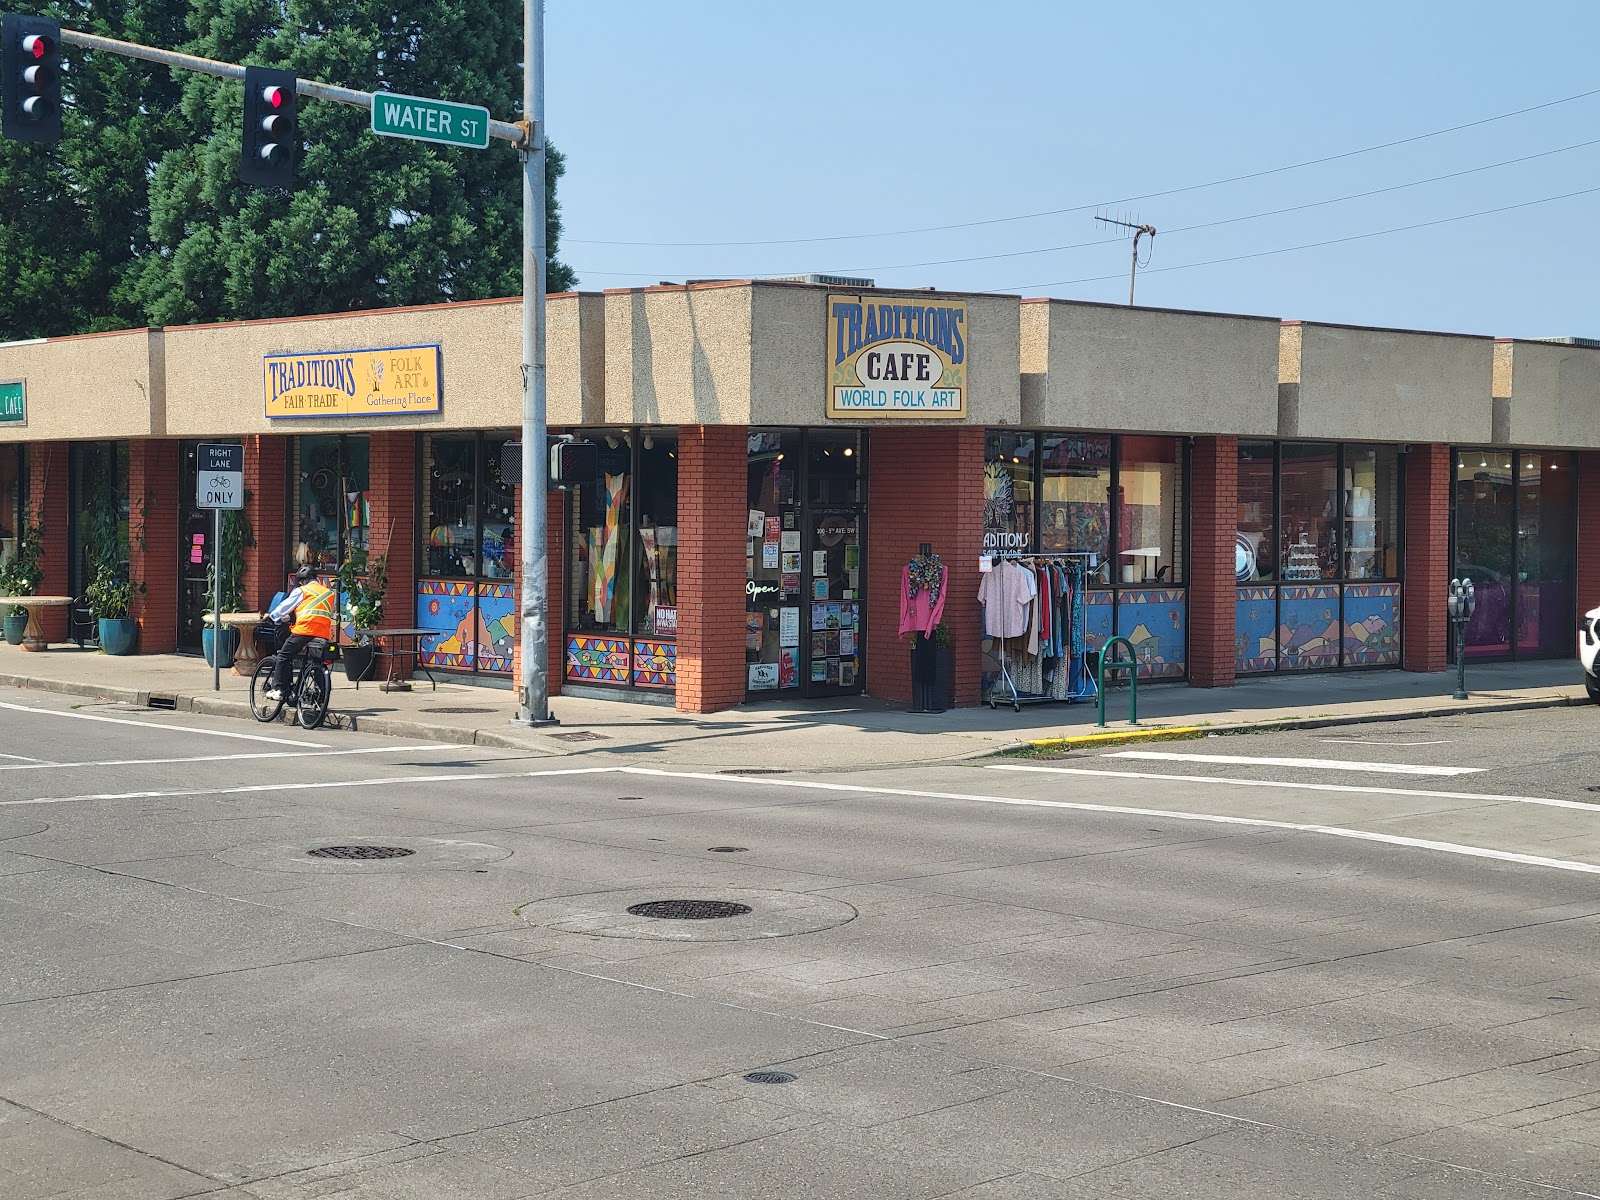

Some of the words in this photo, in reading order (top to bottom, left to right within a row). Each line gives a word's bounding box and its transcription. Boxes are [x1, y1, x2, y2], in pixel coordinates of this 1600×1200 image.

[384, 102, 452, 135] WATER
[460, 119, 479, 138] ST
[832, 302, 964, 366] TRADITIONS
[390, 356, 423, 373] FOLK
[867, 352, 930, 381] CAFE
[269, 357, 355, 403] TRADITIONS
[394, 372, 421, 389] ART
[284, 395, 304, 409] FAIR
[307, 394, 339, 408] TRADE
[366, 393, 407, 409] Gathering
[408, 392, 432, 405] Place
[840, 389, 887, 407] WORLD
[893, 390, 926, 407] FOLK
[931, 390, 956, 407] ART
[209, 448, 232, 457] RIGHT
[210, 459, 231, 468] LANE
[206, 491, 234, 504] ONLY
[983, 532, 1029, 547] ADITIONS
[745, 580, 779, 602] Open
[656, 608, 665, 619] NO
[665, 609, 677, 620] HAT
